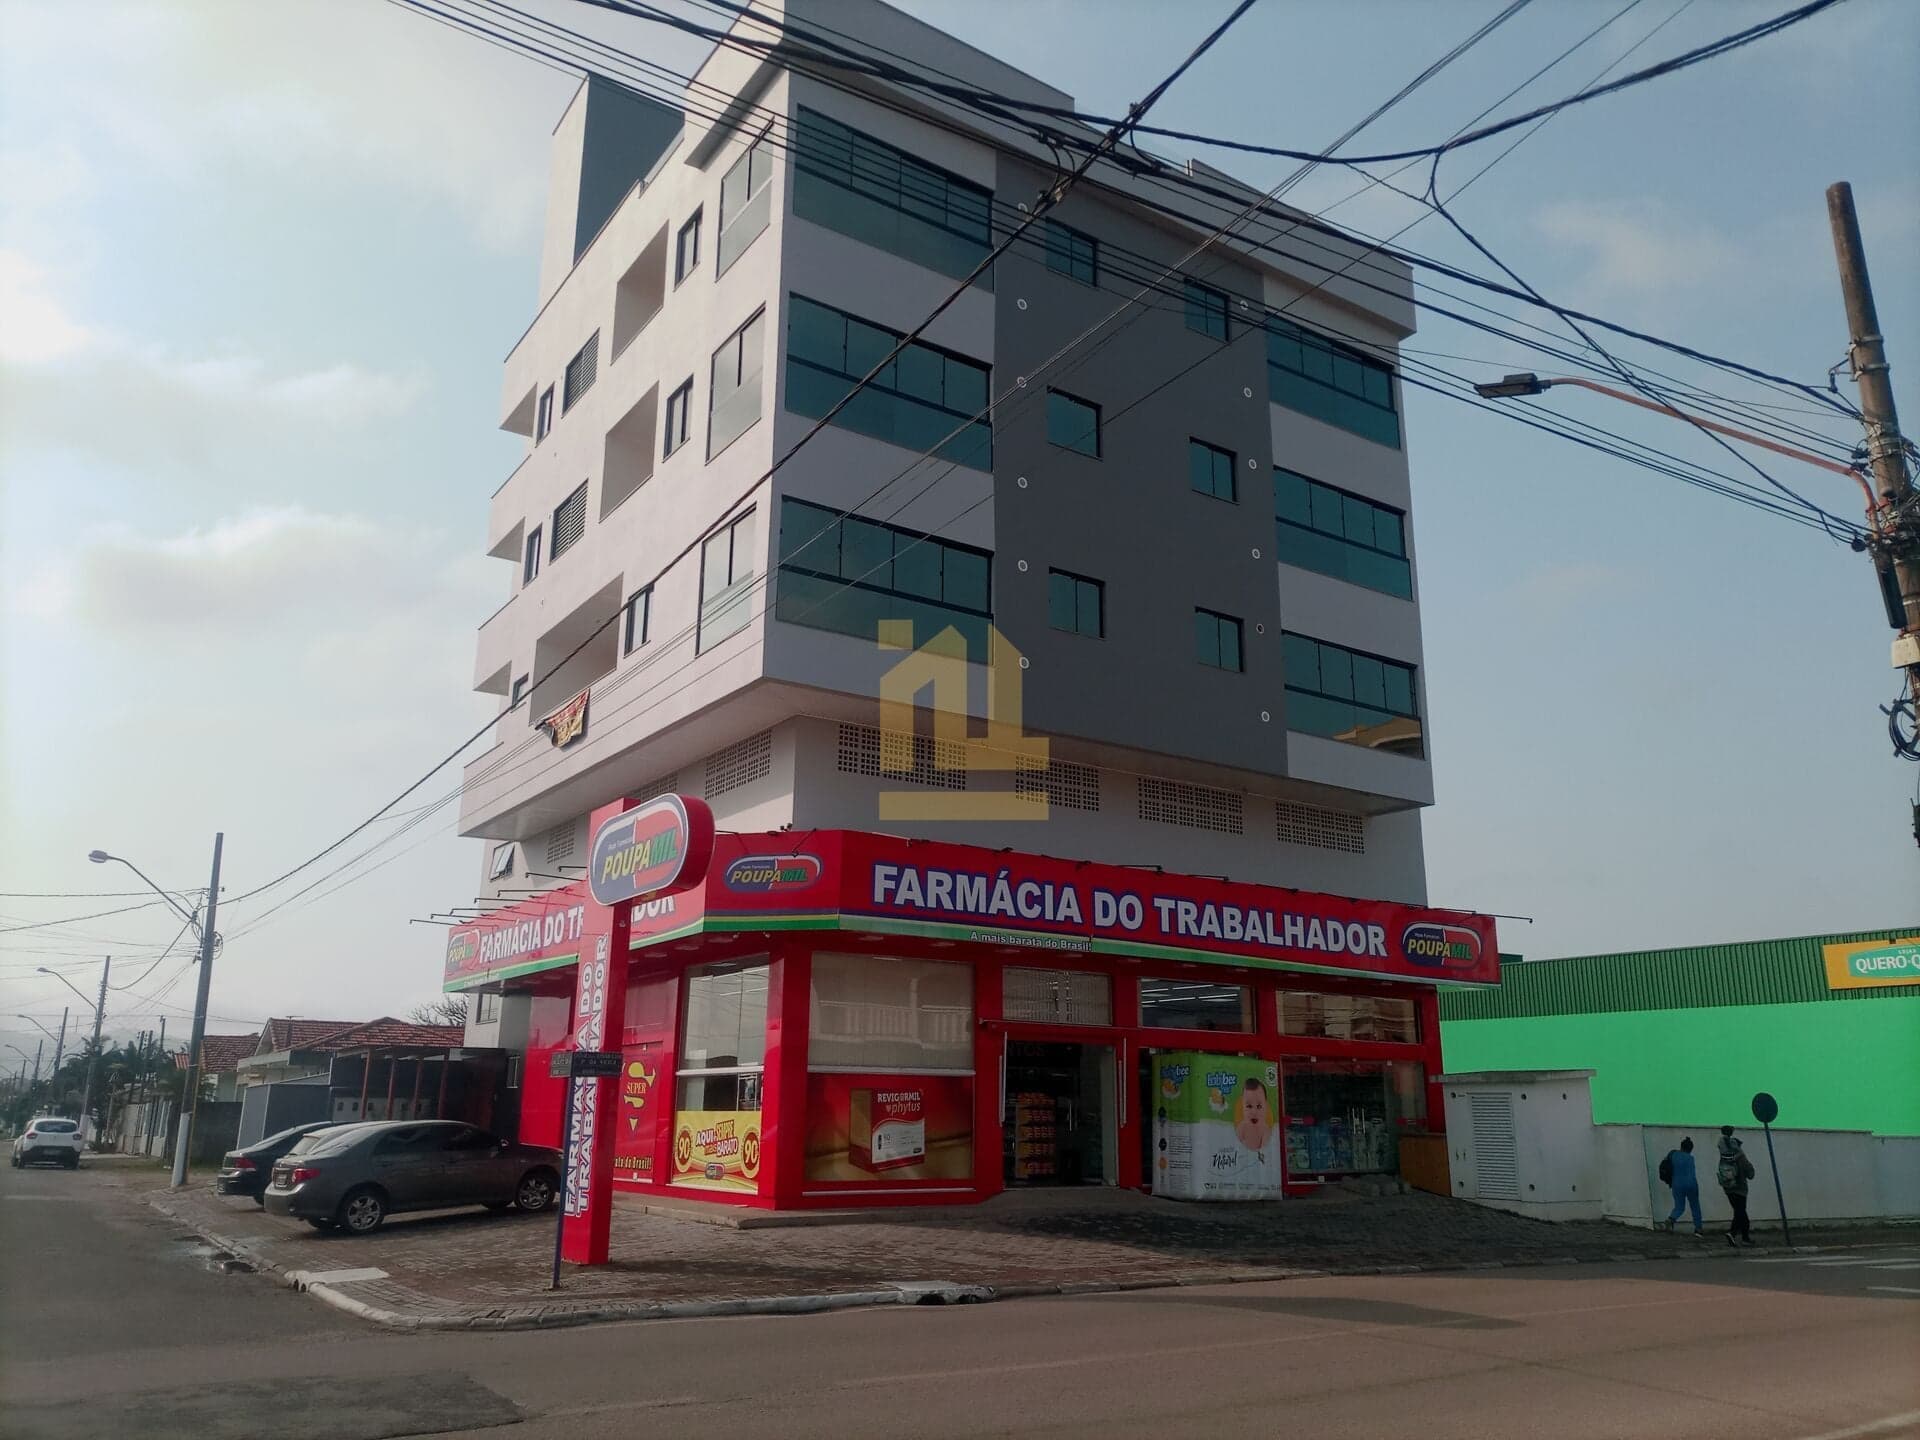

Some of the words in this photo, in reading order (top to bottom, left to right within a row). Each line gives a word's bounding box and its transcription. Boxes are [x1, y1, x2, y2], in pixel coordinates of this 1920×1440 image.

[600, 828, 678, 885] POUPAMIL
[730, 868, 808, 884] POUPAMIL
[873, 864, 1083, 925] FARMÁCIA
[1094, 891, 1144, 930] DO
[1153, 897, 1389, 958] TRABALHADOR
[479, 917, 541, 964] FARMÁCIA
[543, 911, 565, 947] DO
[970, 931, 978, 941] A
[981, 933, 1007, 944] mais
[1009, 935, 1042, 947] barata
[1045, 938, 1058, 948] do
[1407, 938, 1473, 960] POUPAMIL
[579, 964, 592, 1016] DO
[626, 1082, 647, 1094] SUPER
[564, 1021, 588, 1215] FARMAA
[678, 1137, 691, 1159] 90
[695, 1129, 714, 1146] AQUI
[716, 1137, 738, 1157] BARATO
[745, 1139, 758, 1164] 90
